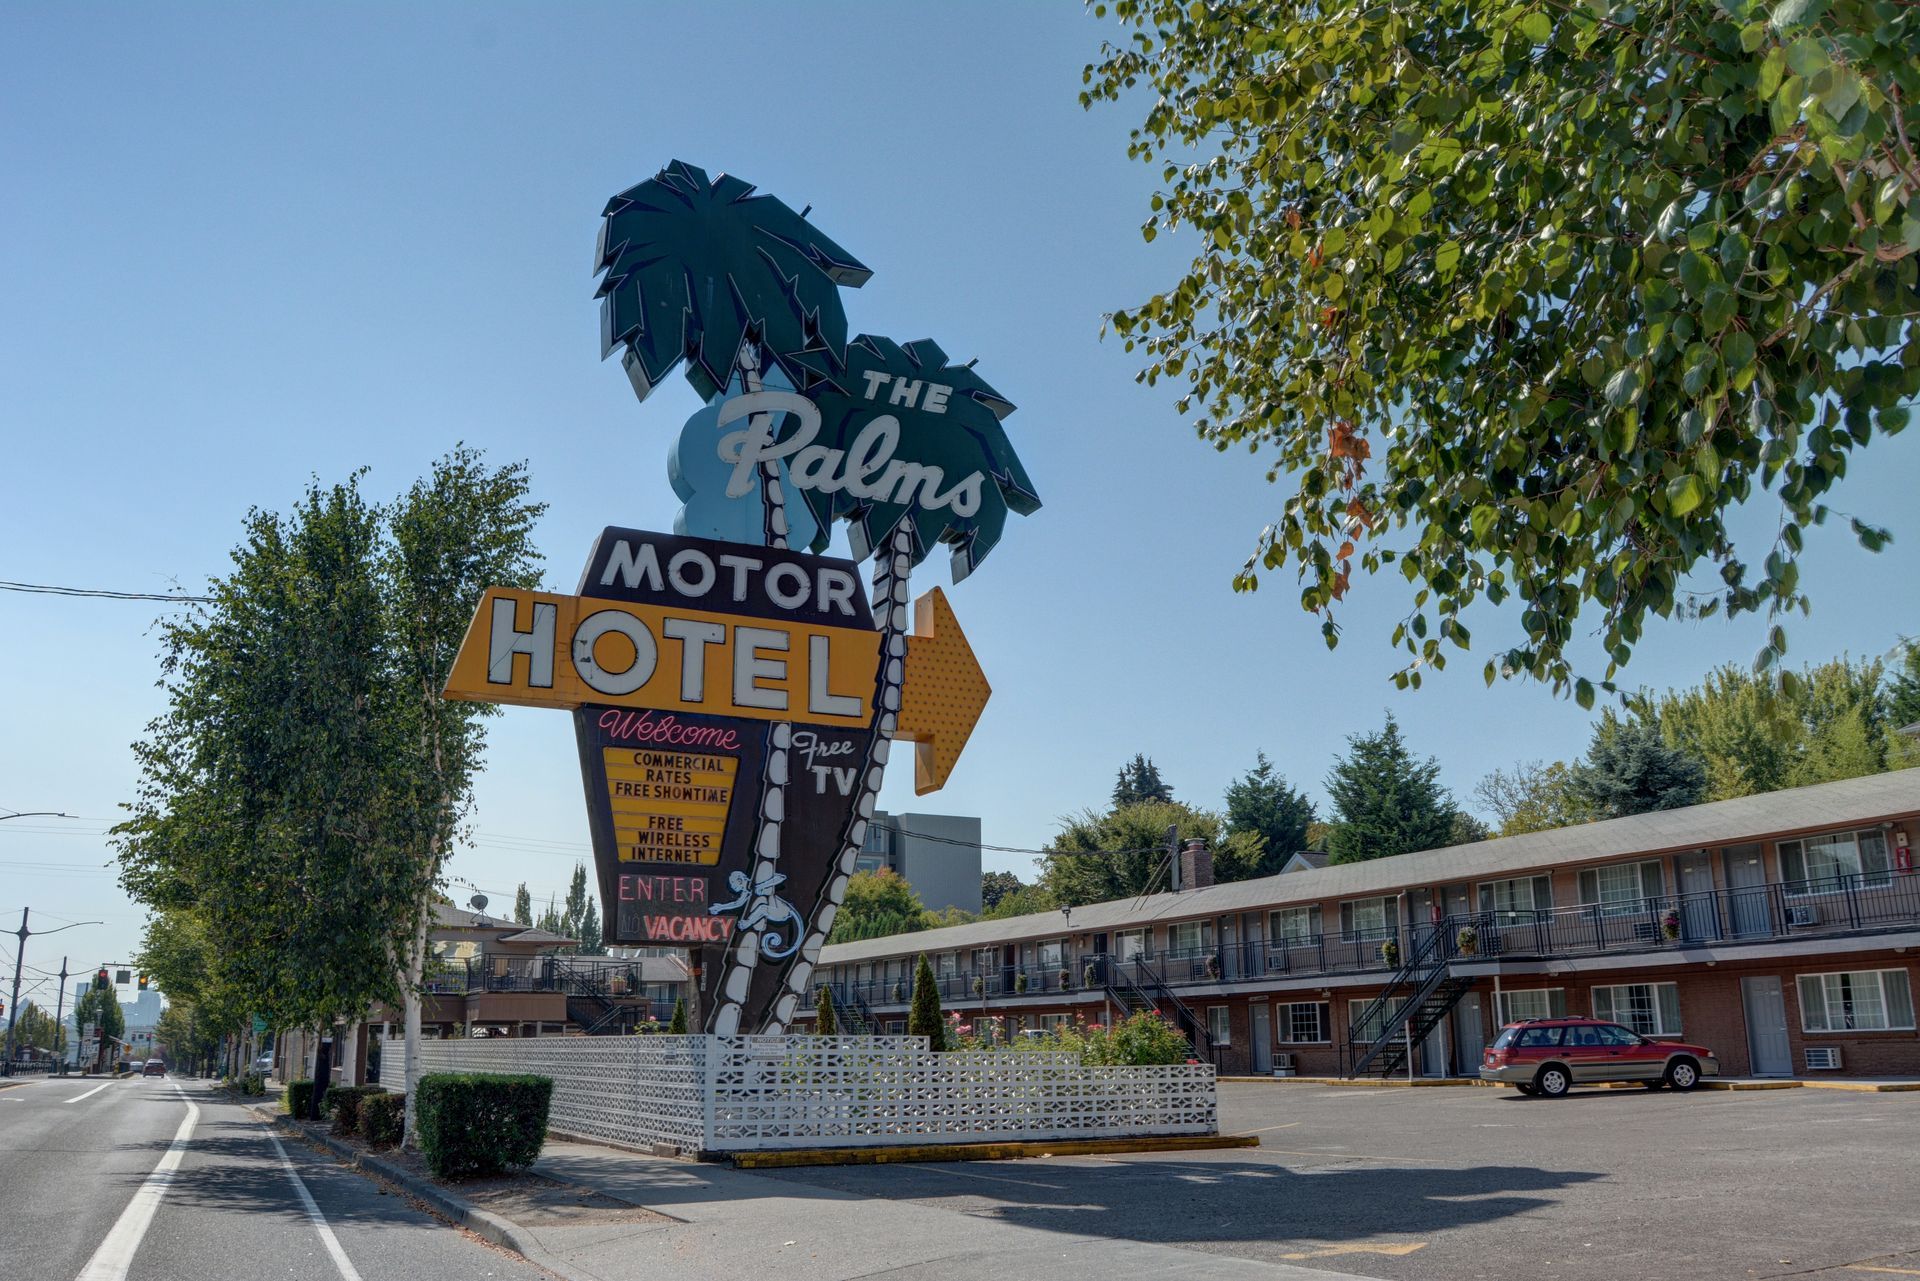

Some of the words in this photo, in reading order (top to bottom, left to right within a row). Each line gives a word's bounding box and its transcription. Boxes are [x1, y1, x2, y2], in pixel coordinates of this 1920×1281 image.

[863, 369, 953, 414] THE
[717, 391, 986, 518] Palms
[600, 539, 857, 617] MOTOR
[487, 597, 863, 717] HOTEL
[599, 709, 741, 749] Welcome
[633, 752, 724, 772] COMMERCIAL
[791, 731, 856, 770] Free
[646, 769, 691, 784] RATES
[811, 765, 857, 796] TV
[615, 782, 650, 798] FREE
[654, 785, 728, 803] SHOWTIME
[648, 816, 683, 831] FREE
[638, 831, 710, 848] WIRELESS
[631, 847, 702, 863] INTERNET
[619, 876, 705, 902] ENTER
[643, 914, 735, 941] VACANCY
